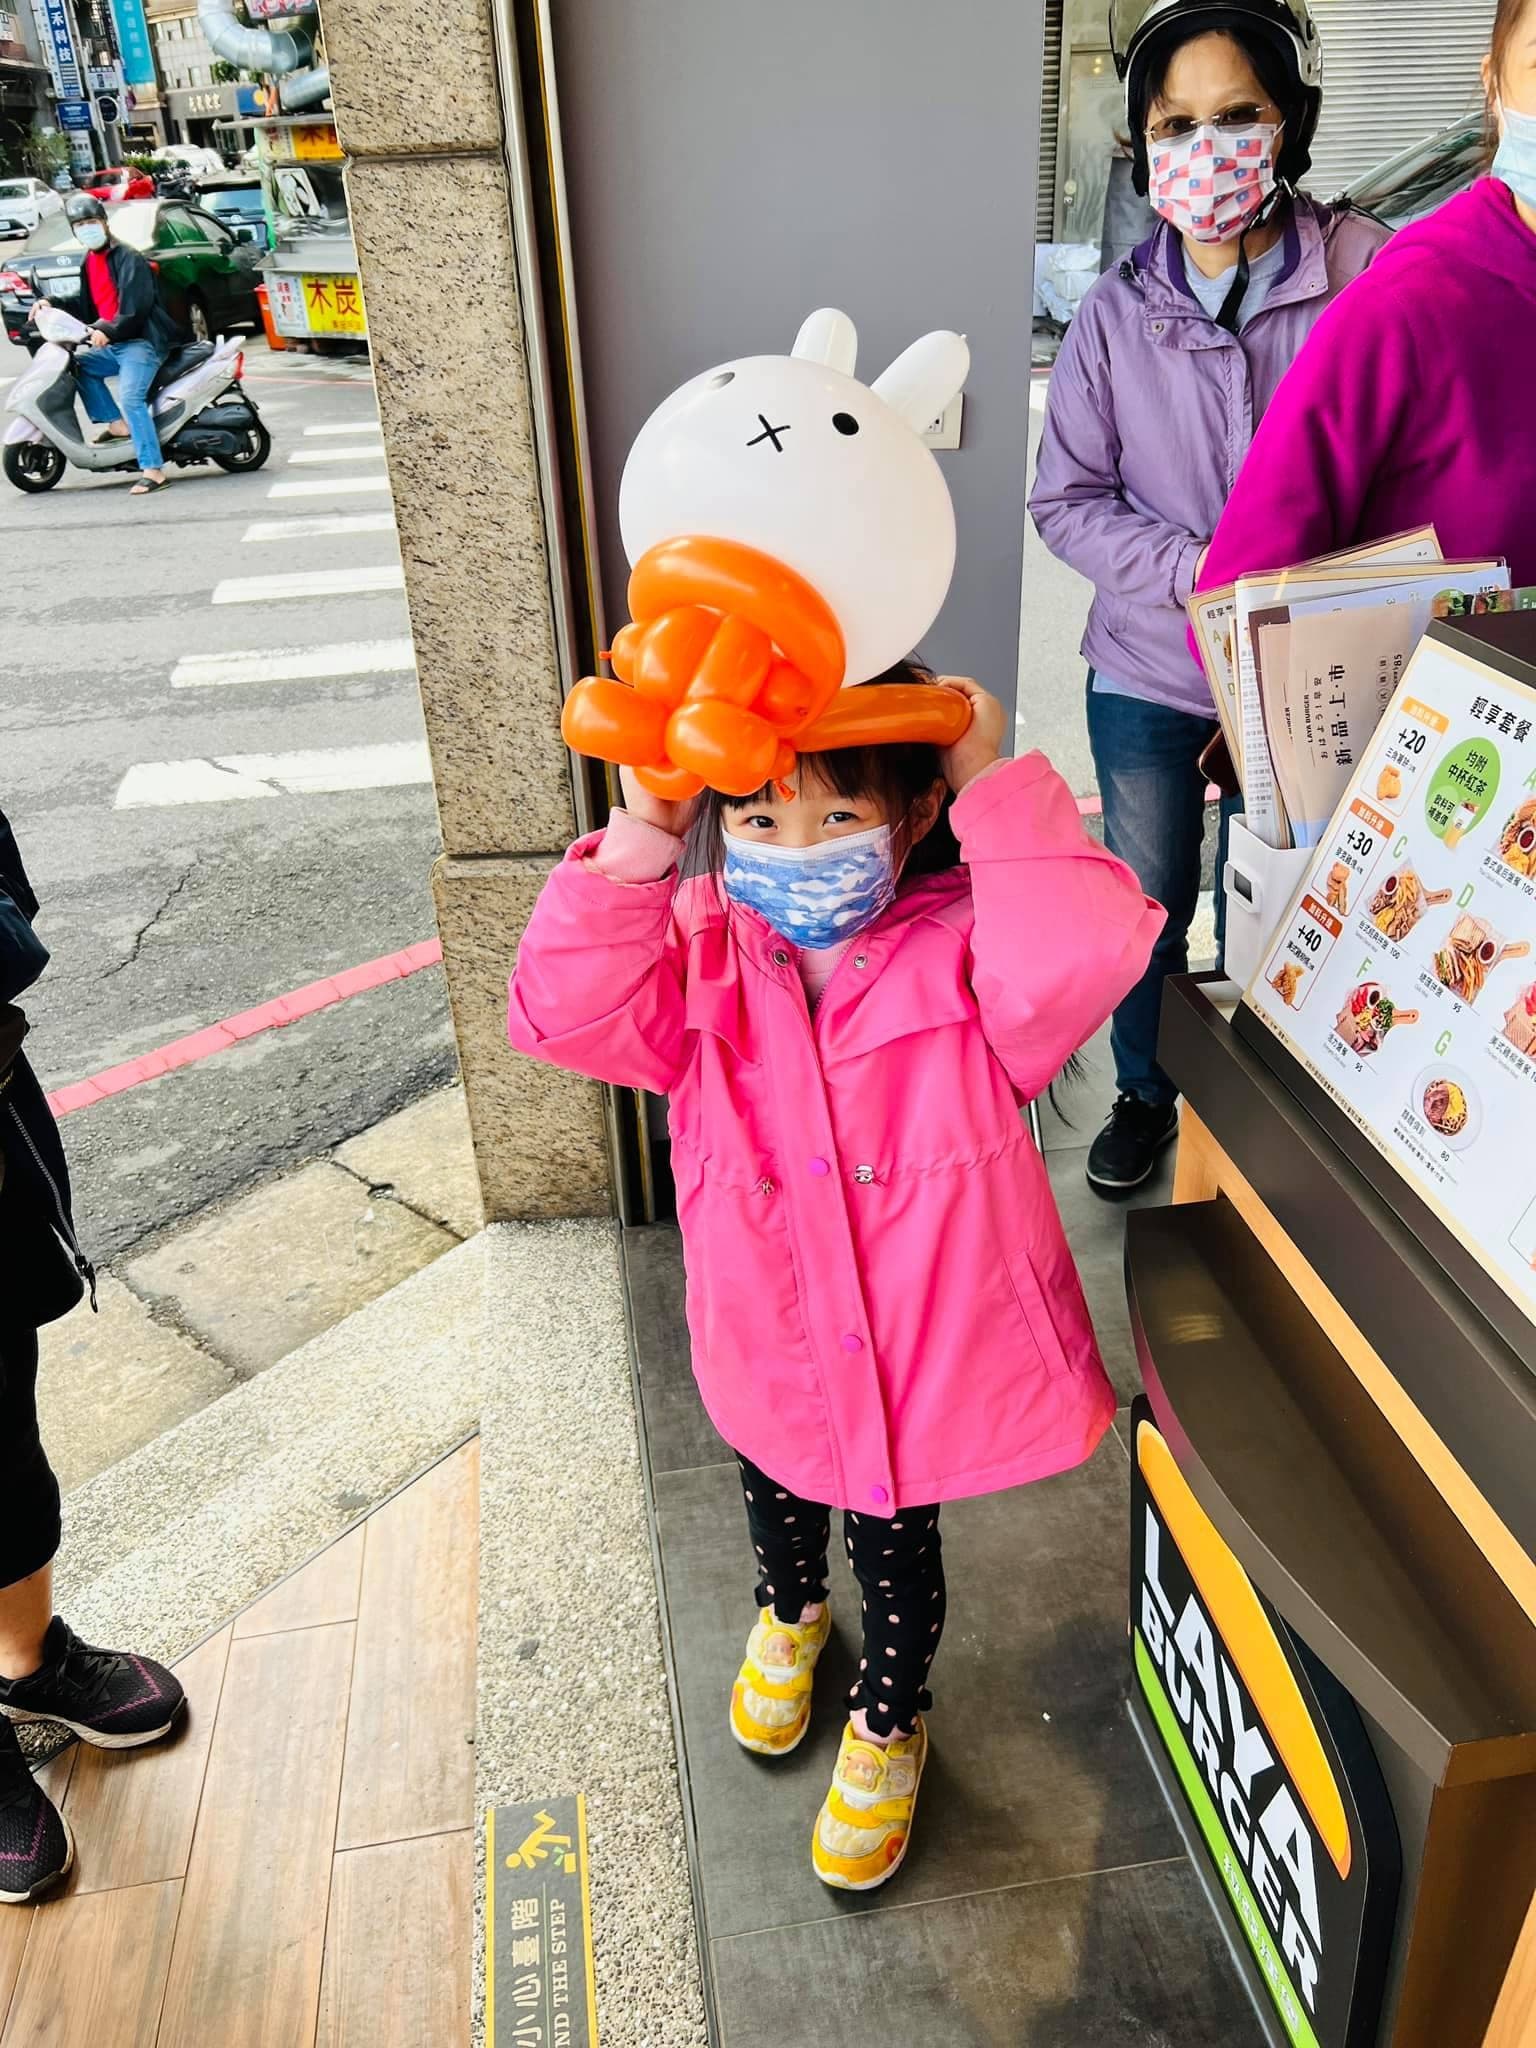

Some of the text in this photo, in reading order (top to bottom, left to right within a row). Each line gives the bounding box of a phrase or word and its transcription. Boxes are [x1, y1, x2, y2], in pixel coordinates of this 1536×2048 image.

[307, 279, 360, 316] 木炭
[1469, 695, 1532, 743] 輕享套餐
[1305, 724, 1313, 743] LAYA
[1398, 728, 1427, 755] +20
[1465, 749, 1488, 773] 均附
[1448, 763, 1488, 797] 中杯紅茶
[1346, 829, 1373, 856] +30
[1393, 835, 1408, 858] C
[1456, 883, 1474, 908] D
[1522, 883, 1534, 896] 100
[1298, 925, 1322, 952] +40
[1390, 947, 1400, 960] 100
[1356, 957, 1372, 978] F
[1452, 1003, 1462, 1013] 95
[1434, 1030, 1452, 1057] G
[1354, 1062, 1364, 1072] 95
[1440, 1151, 1450, 1162] 80
[1145, 1503, 1323, 1955] LAYA
[1142, 1582, 1321, 2014] BURGER
[549, 1898, 567, 1956] STEP
[511, 1897, 542, 2048] 小心臺階
[552, 1960, 569, 2008] THE
